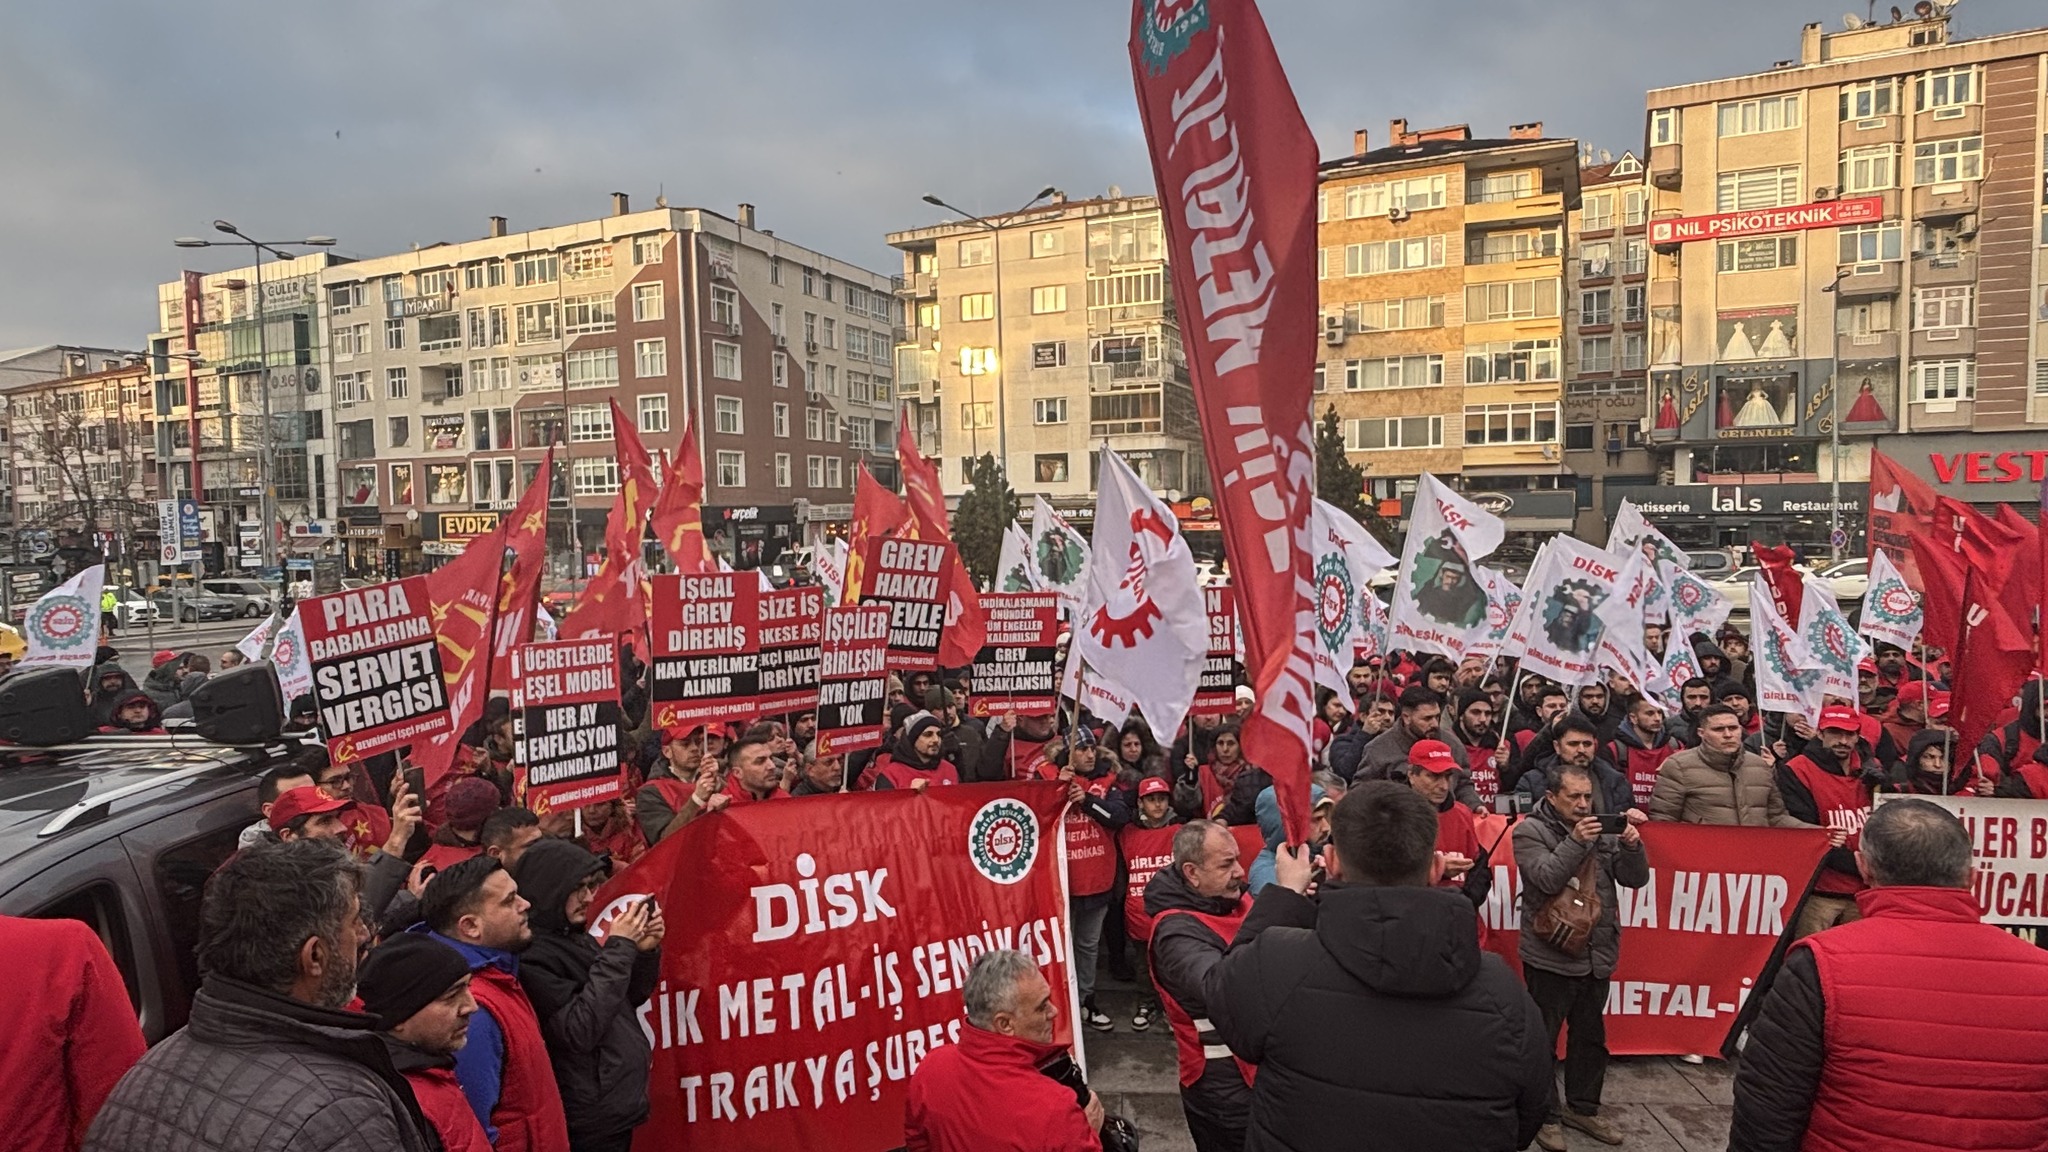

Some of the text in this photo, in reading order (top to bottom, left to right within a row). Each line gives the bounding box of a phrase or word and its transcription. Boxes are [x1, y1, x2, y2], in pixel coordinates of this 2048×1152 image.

[268, 281, 298, 297] GÜLER
[1783, 500, 1859, 512] Restauant
[880, 540, 946, 573] GREV
[1572, 556, 1620, 583] DİSK
[679, 575, 735, 603] İŞGAL
[874, 572, 939, 601] HAKKI
[322, 584, 411, 631] PARA
[682, 602, 733, 625] GREV
[801, 592, 820, 619] İŞ
[862, 599, 943, 630] EVLE
[990, 608, 1035, 620] ÖNÜNDEKİ
[310, 616, 432, 661] BABALARINA
[668, 623, 746, 652] DİRENİŞ
[801, 623, 820, 643] AŞ
[825, 606, 888, 647] İŞÇİLER
[985, 620, 1043, 632] ÜM ENGELLER
[986, 632, 1040, 643] KALDIRILSIN
[525, 643, 614, 672] ÜCRETLERDE
[655, 655, 758, 680] HAK VERİLMEZ
[759, 649, 782, 667] KÇİ
[822, 644, 886, 677] BİRLEŞİN
[995, 648, 1027, 661] GREV
[316, 642, 434, 700] SERVET
[971, 661, 1052, 677] YASAKLAMAK
[526, 665, 615, 703] EŞEL MOBİL
[683, 677, 732, 697] ALINIR
[819, 678, 884, 706] AYRI GAYRI
[971, 676, 1052, 692] YASAKLANSIN
[322, 675, 443, 737] VERGİSİ
[546, 703, 598, 733] HER AY
[677, 702, 755, 719] DEVRİMCİ İŞÇİ PARTİSİ
[839, 705, 864, 727] YOK
[356, 715, 446, 751] DEVRİMCİ İŞÇİ PARTİSİ
[529, 724, 617, 762] ENFLASYON
[530, 751, 618, 785] ORANINDA ZAM
[582, 785, 595, 799] İŞÇİ
[994, 833, 1015, 847] DİSK
[750, 853, 896, 943] DİSK
[1668, 870, 1788, 936] HAYIR
[719, 943, 904, 1040] METAL-İŞ
[680, 1048, 857, 1123] TRAKYA
